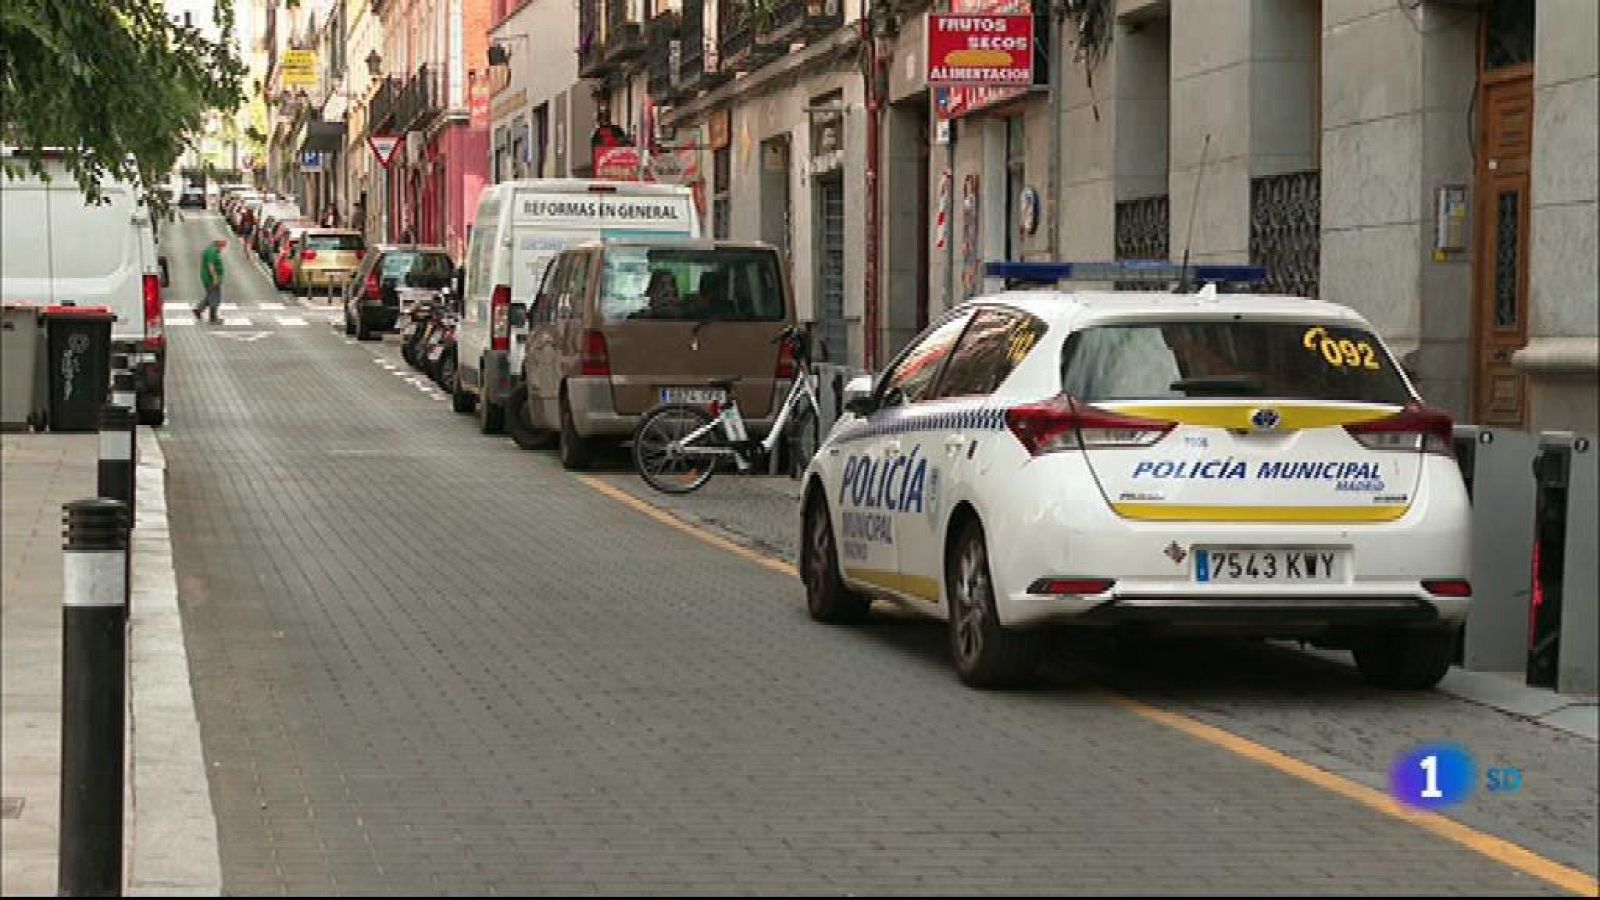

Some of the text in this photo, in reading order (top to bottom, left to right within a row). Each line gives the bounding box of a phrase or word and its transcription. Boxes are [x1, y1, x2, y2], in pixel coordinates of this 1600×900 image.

[938, 18, 1007, 32] FRUTOS
[967, 36, 1028, 50] SECOS
[524, 201, 679, 219] REFORMAS EN GENERAL
[1321, 339, 1380, 370] 092
[839, 443, 928, 513] POLICÍA
[1131, 455, 1382, 480] POLICÍA MUNICIPAL
[1212, 552, 1335, 580] 7543 KWY
